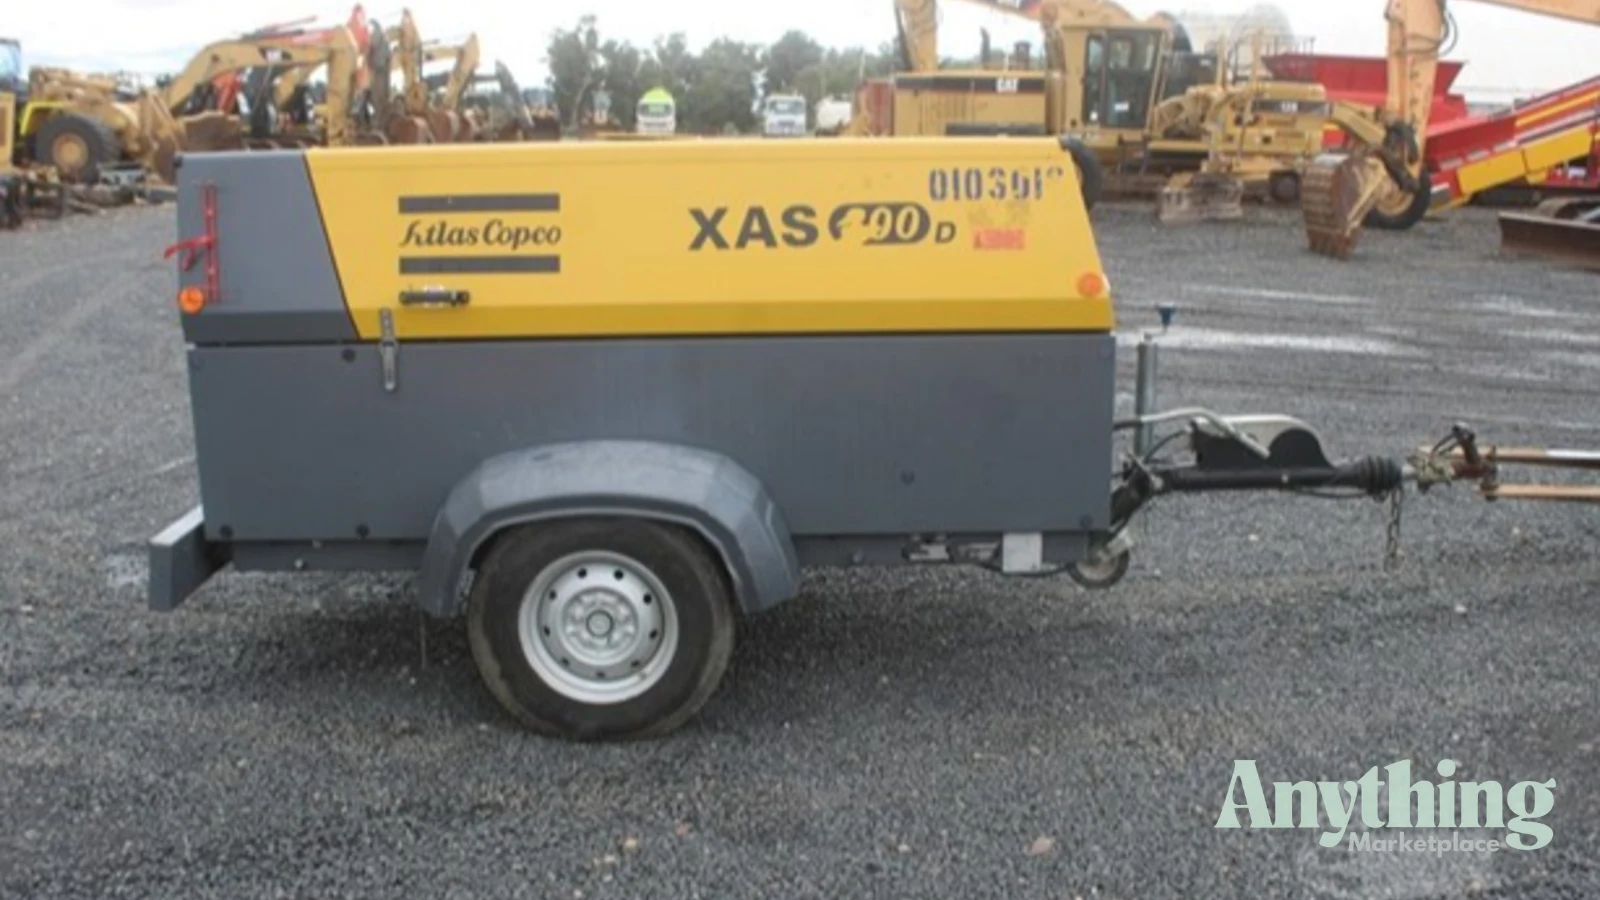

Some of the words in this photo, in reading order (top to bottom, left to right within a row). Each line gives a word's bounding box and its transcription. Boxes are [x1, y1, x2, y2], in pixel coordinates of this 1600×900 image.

[399, 219, 480, 248] Atlas
[482, 217, 562, 251] Copco
[688, 205, 820, 252] XAS
[935, 220, 957, 244] D
